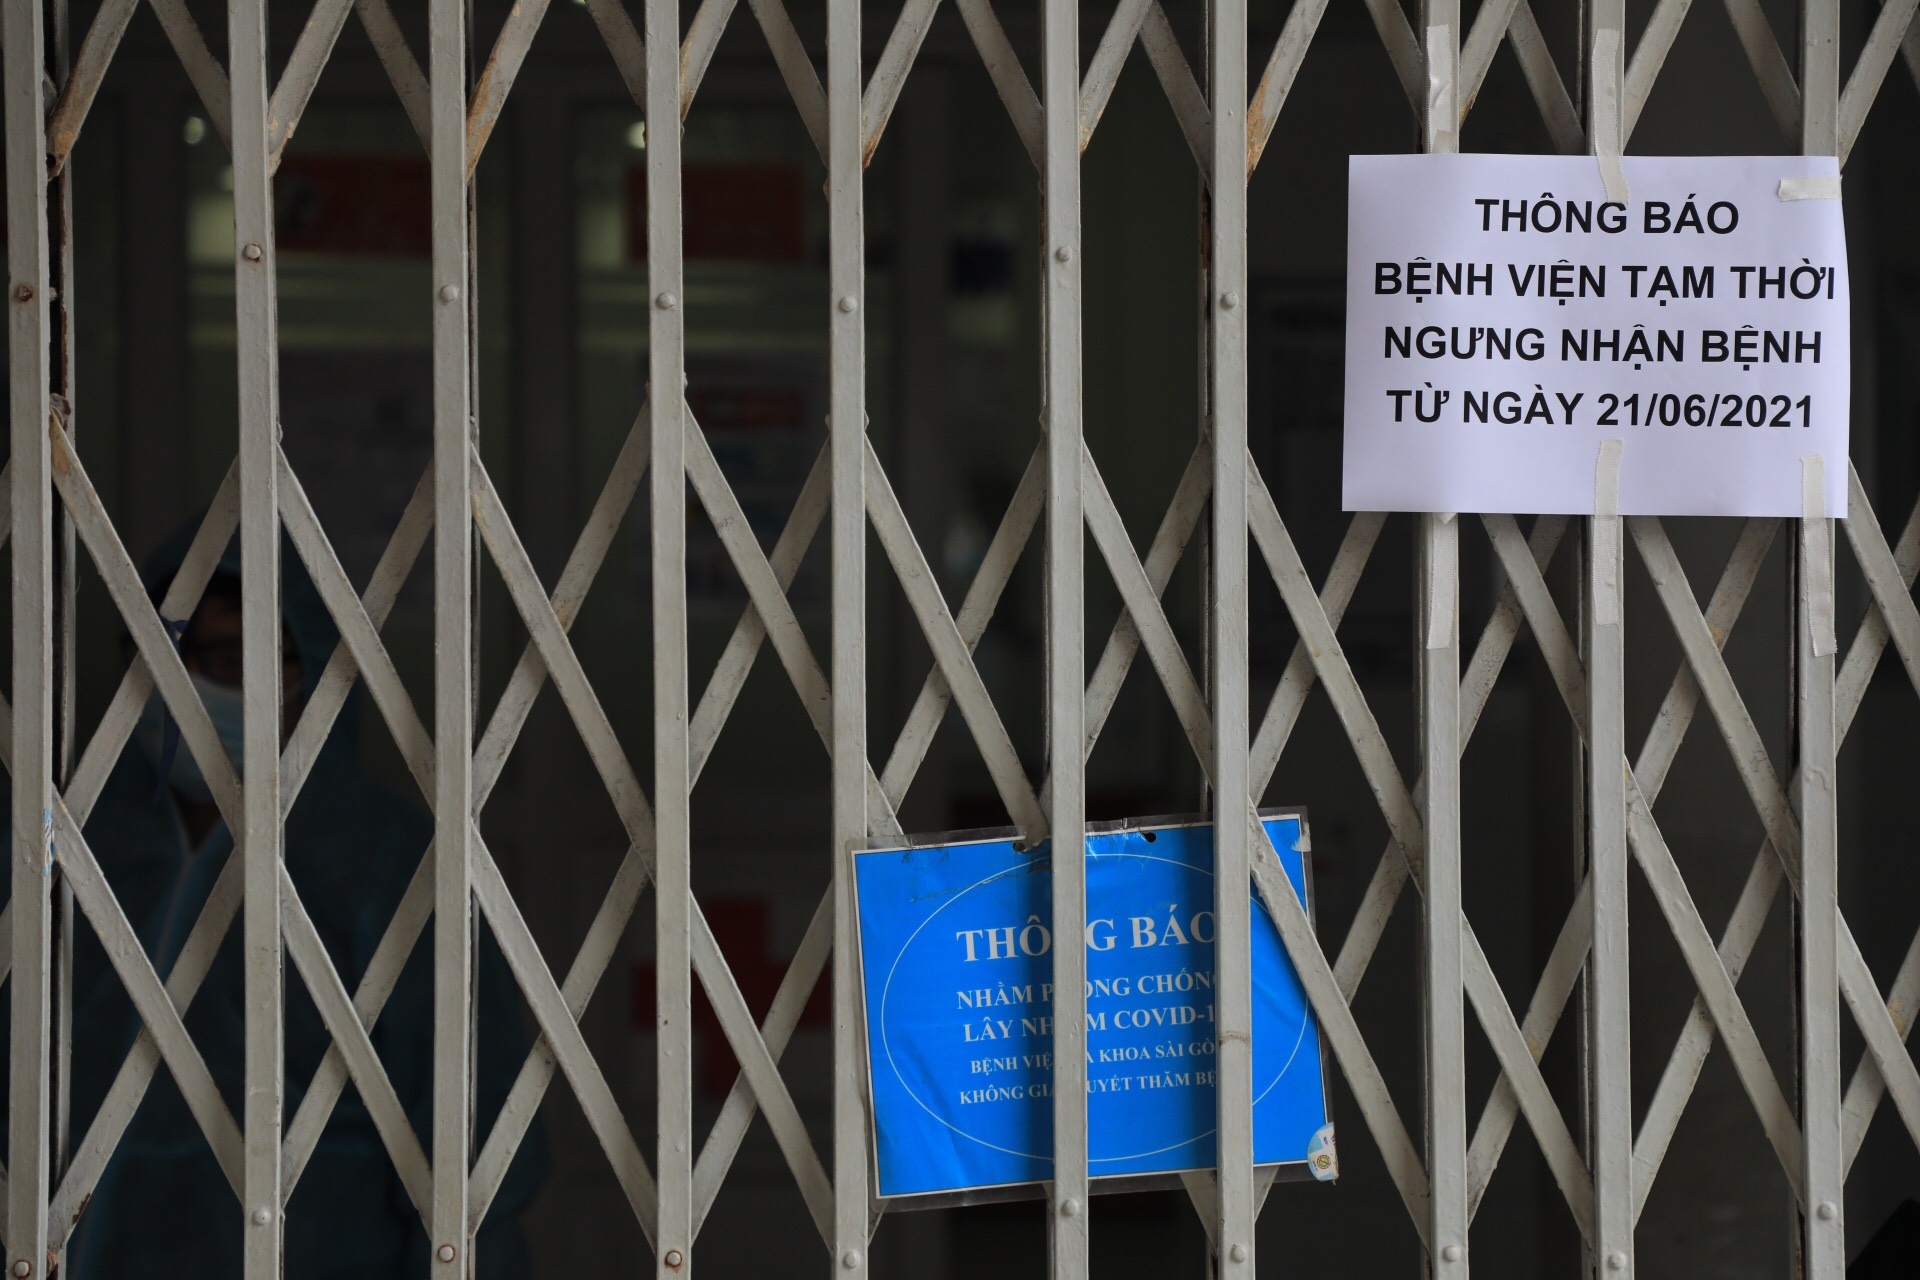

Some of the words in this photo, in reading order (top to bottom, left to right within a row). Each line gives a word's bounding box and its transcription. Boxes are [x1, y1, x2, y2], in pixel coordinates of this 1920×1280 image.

[1474, 192, 1627, 234] THÔNG
[1643, 193, 1740, 235] BÁO
[1374, 256, 1493, 304] BỆNH
[1507, 259, 1606, 306] VIỆN
[1621, 265, 1715, 307] TẠM
[1729, 257, 1835, 300] THỜI
[1384, 325, 1545, 362] NGƯNG
[1561, 323, 1685, 371] NHẬN
[1701, 324, 1822, 372] BỆNH
[1385, 381, 1450, 423] TỪ
[1463, 384, 1585, 425] NGÀY
[1596, 393, 1812, 428] 21/06/2021
[956, 915, 1117, 962] THÔG
[1128, 904, 1217, 949] BÁO
[1041, 977, 1131, 1002] PNG
[1137, 967, 1215, 995] CHỐN
[963, 1016, 1013, 1042] LÂY
[1021, 1012, 1107, 1037] NHM
[1113, 1004, 1215, 1030] COVID-1
[970, 1057, 1018, 1076] BỆNH
[1022, 1053, 1053, 1070] VIỆ
[1099, 1047, 1151, 1063] KHOA
[1155, 1041, 1185, 1058] SÀI
[1188, 1038, 1215, 1056] GÒ
[960, 1084, 1024, 1105] KHÔNG
[1087, 1074, 1132, 1094] UYẾT
[1137, 1070, 1190, 1090] THĂM
[1195, 1069, 1216, 1088] BỆ
